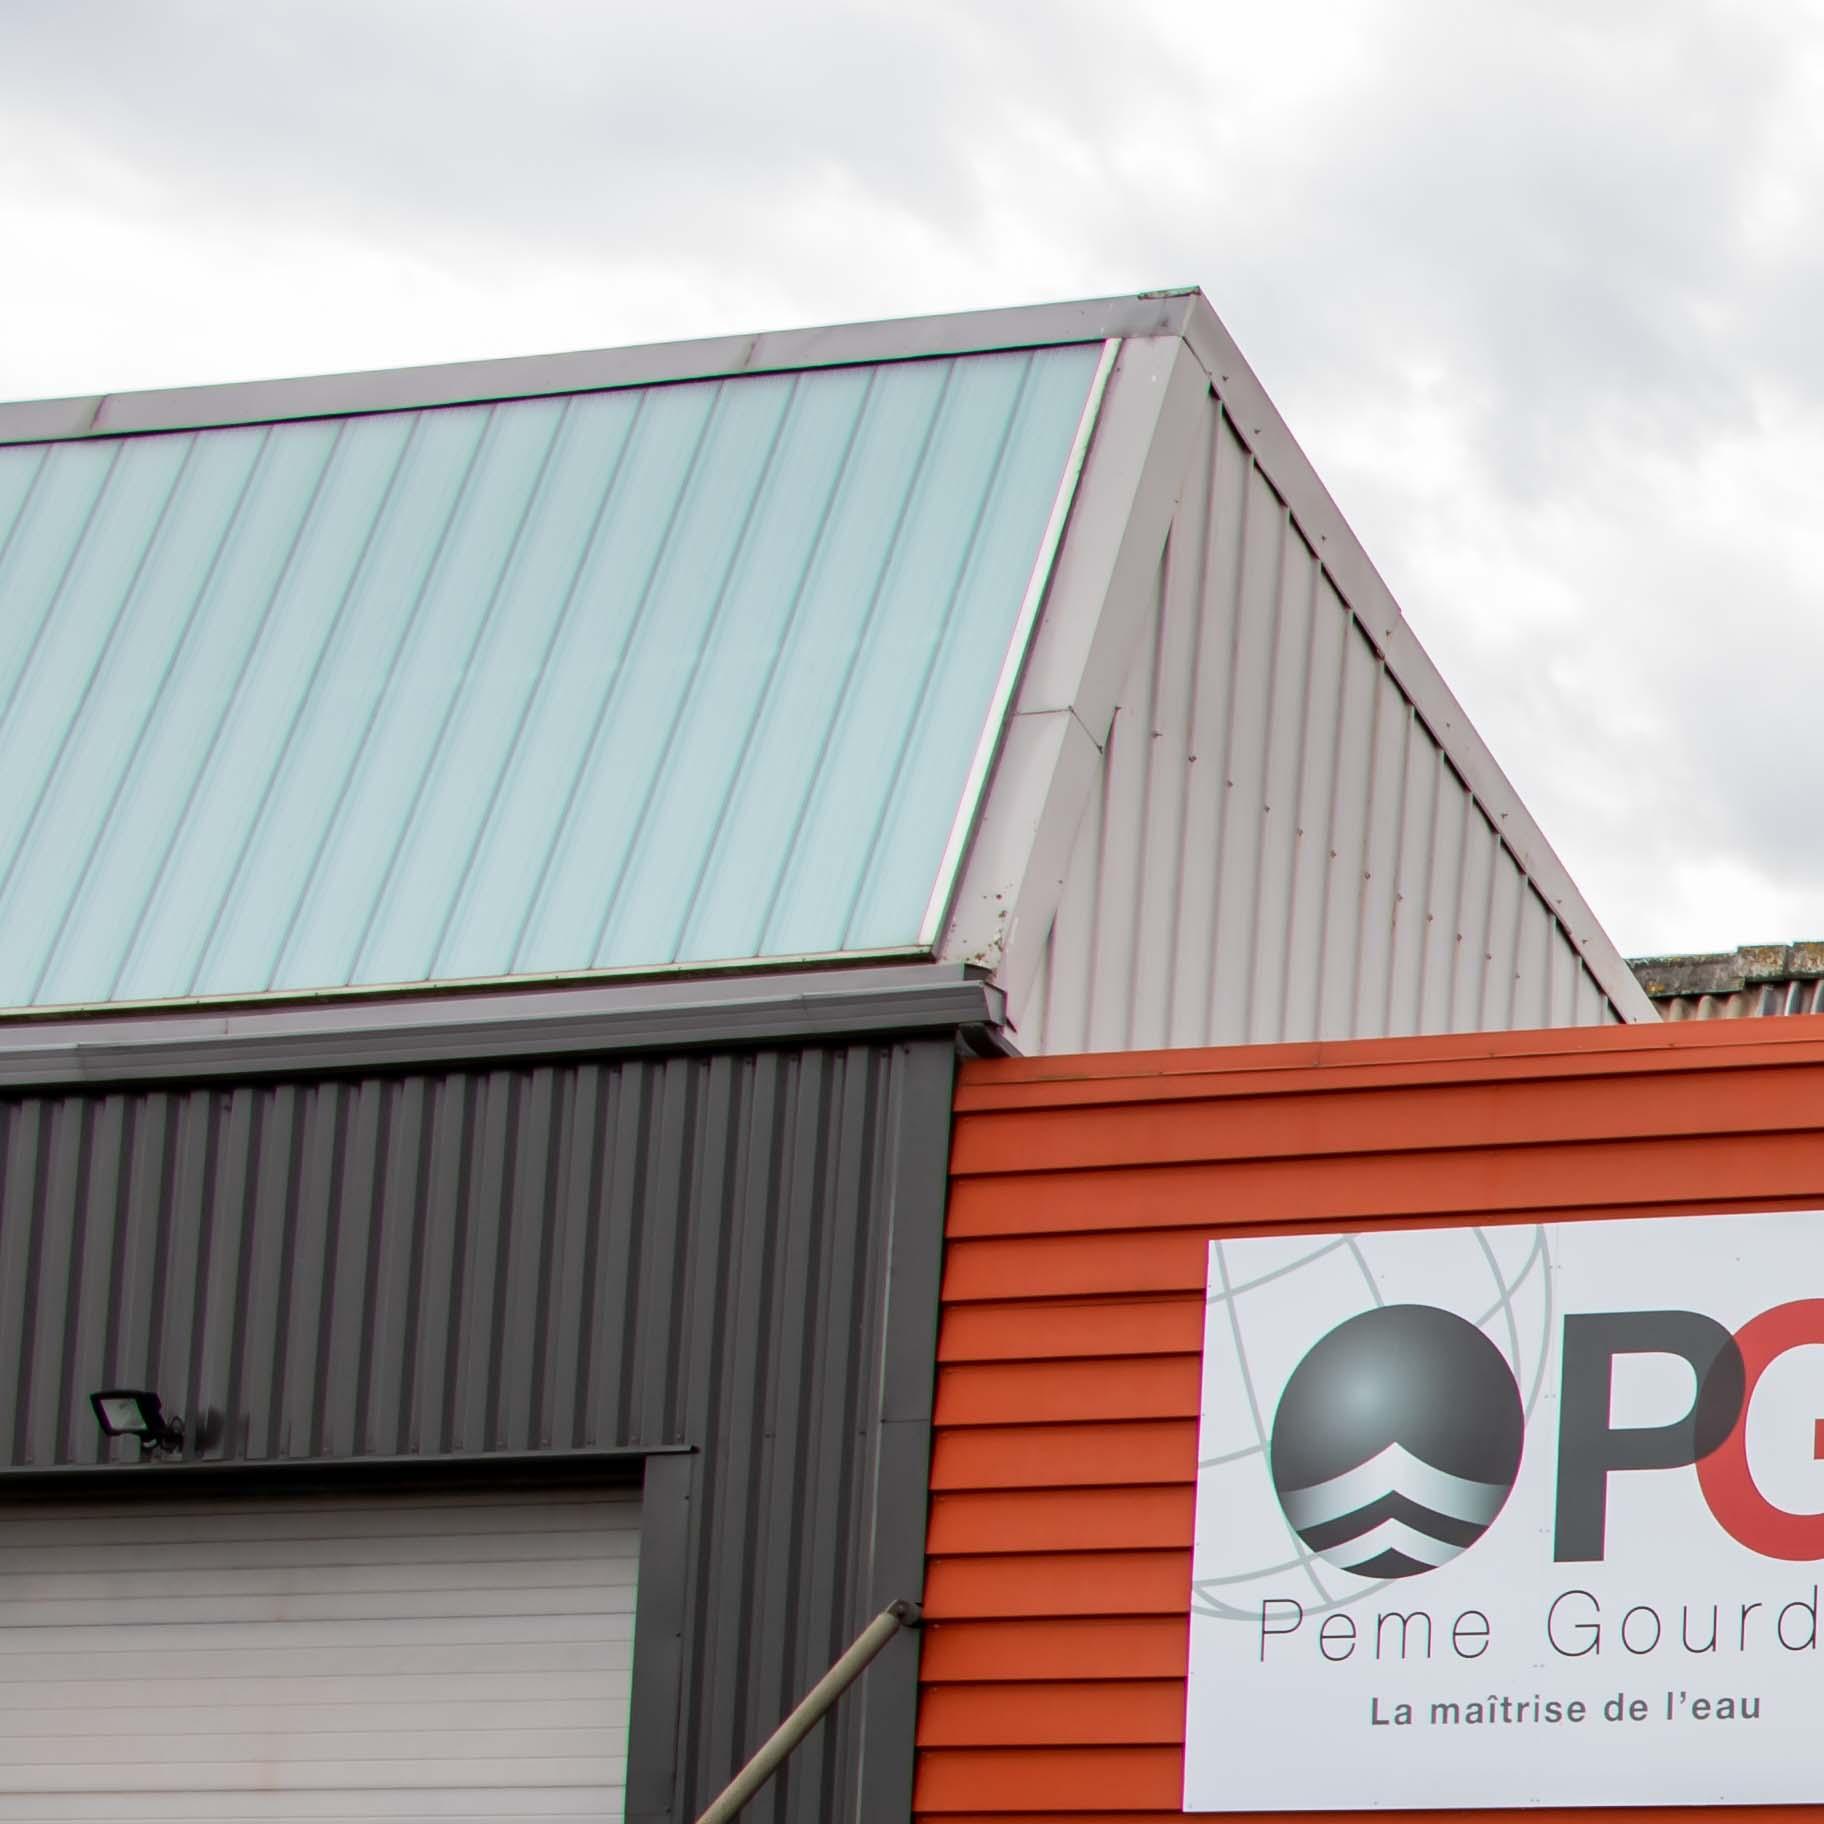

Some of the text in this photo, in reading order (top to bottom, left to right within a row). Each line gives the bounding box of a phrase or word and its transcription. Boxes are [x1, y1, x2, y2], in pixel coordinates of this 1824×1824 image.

[1258, 1597, 1492, 1663] Peme
[1370, 1690, 1761, 1727] La maîtrise de l'eau
